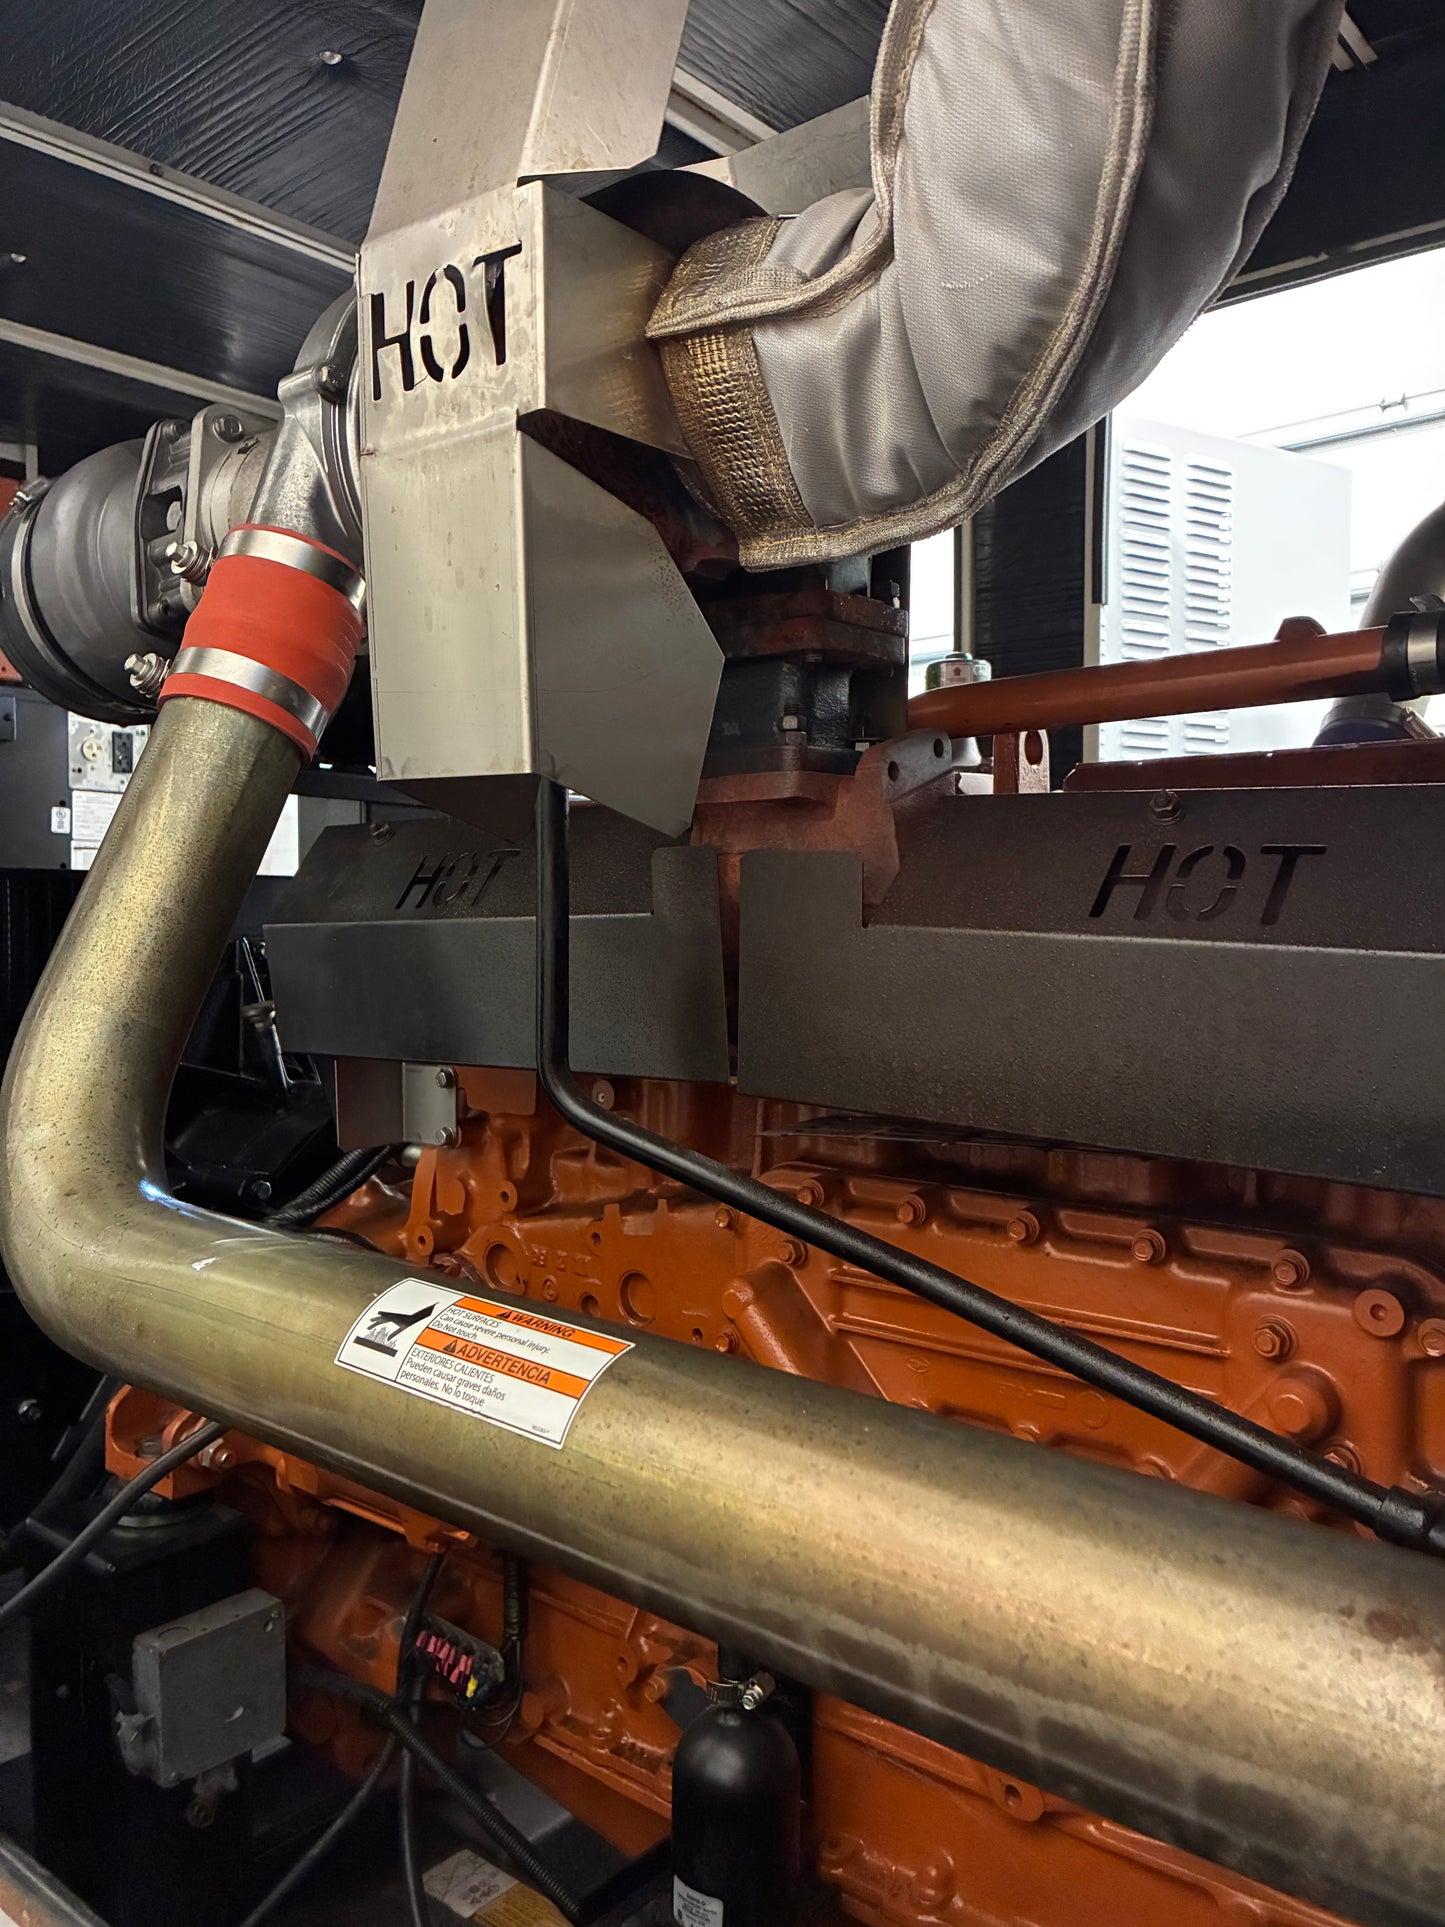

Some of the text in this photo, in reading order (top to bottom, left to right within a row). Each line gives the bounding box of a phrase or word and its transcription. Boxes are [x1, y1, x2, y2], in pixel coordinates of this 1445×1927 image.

[370, 240, 523, 402] HOT
[394, 848, 523, 910] HOT
[1088, 842, 1328, 926] HOT
[432, 1320, 478, 1340] Do Not touch.
[440, 1314, 551, 1354] Can cause severe personal injury.
[446, 1307, 501, 1328] HOT SURFACES
[512, 1313, 576, 1338] WARNING
[406, 1357, 507, 1402] Pueden causar graves daños
[411, 1347, 496, 1384] EXTERIORES CALIENTES
[456, 1343, 552, 1385] ADVERTENCIA
[400, 1369, 485, 1407] personales. No lo toque
